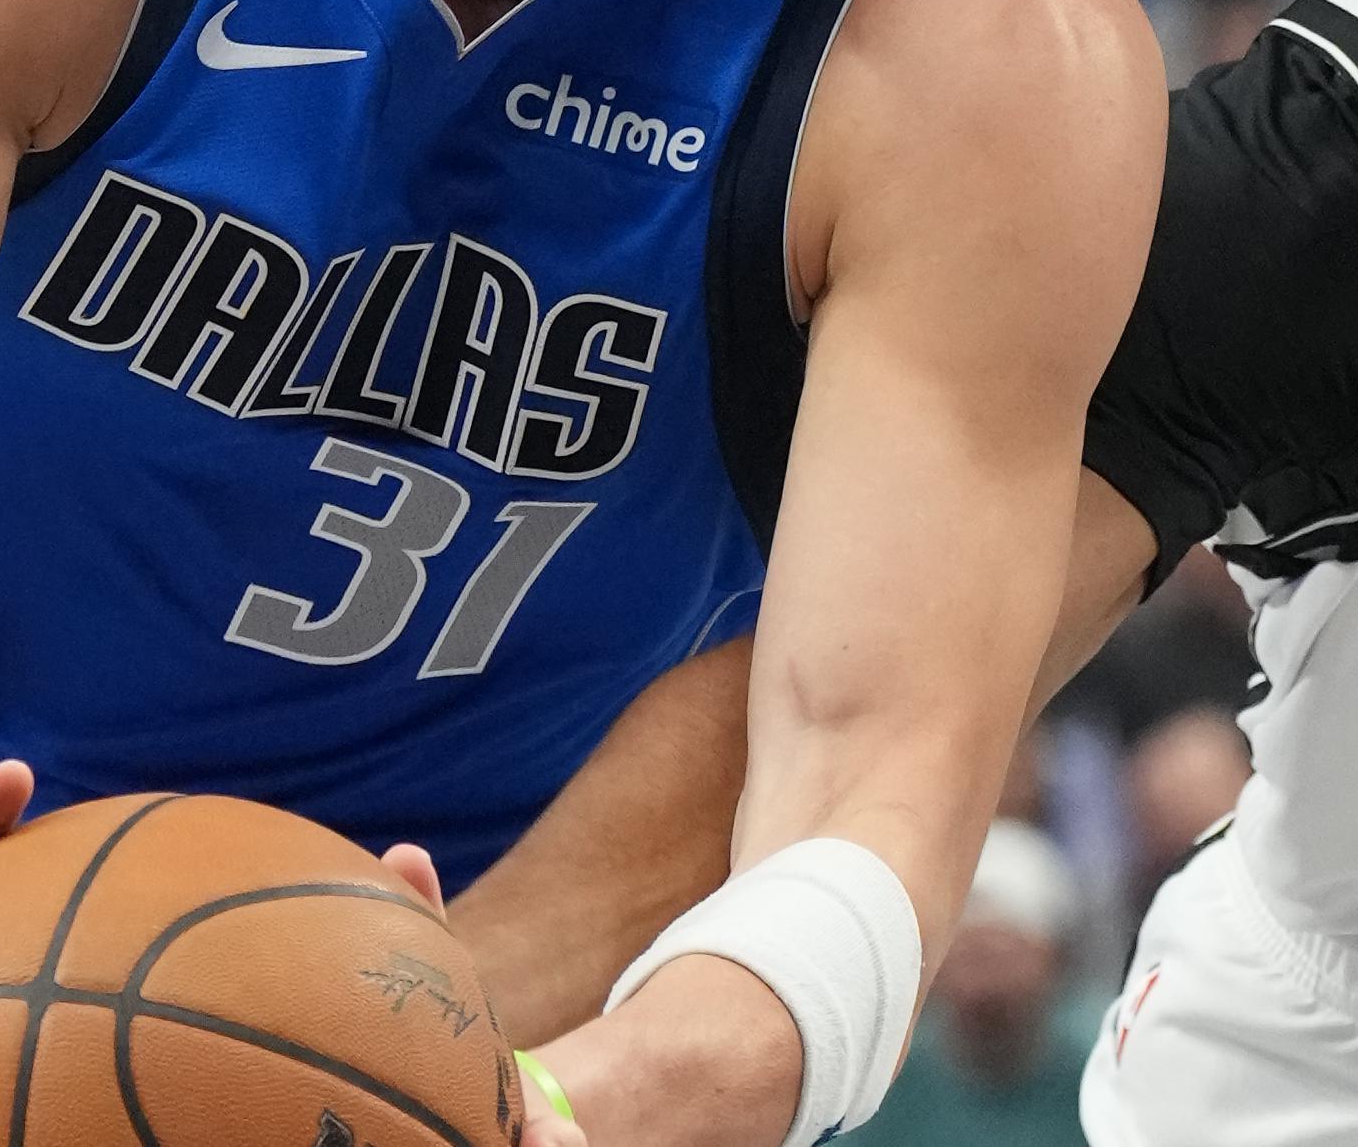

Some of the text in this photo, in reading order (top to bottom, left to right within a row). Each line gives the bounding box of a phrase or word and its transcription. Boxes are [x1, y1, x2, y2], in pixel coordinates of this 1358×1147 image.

[506, 74, 706, 173] chime
[18, 170, 668, 481] DALLAS
[224, 436, 598, 680] 31
